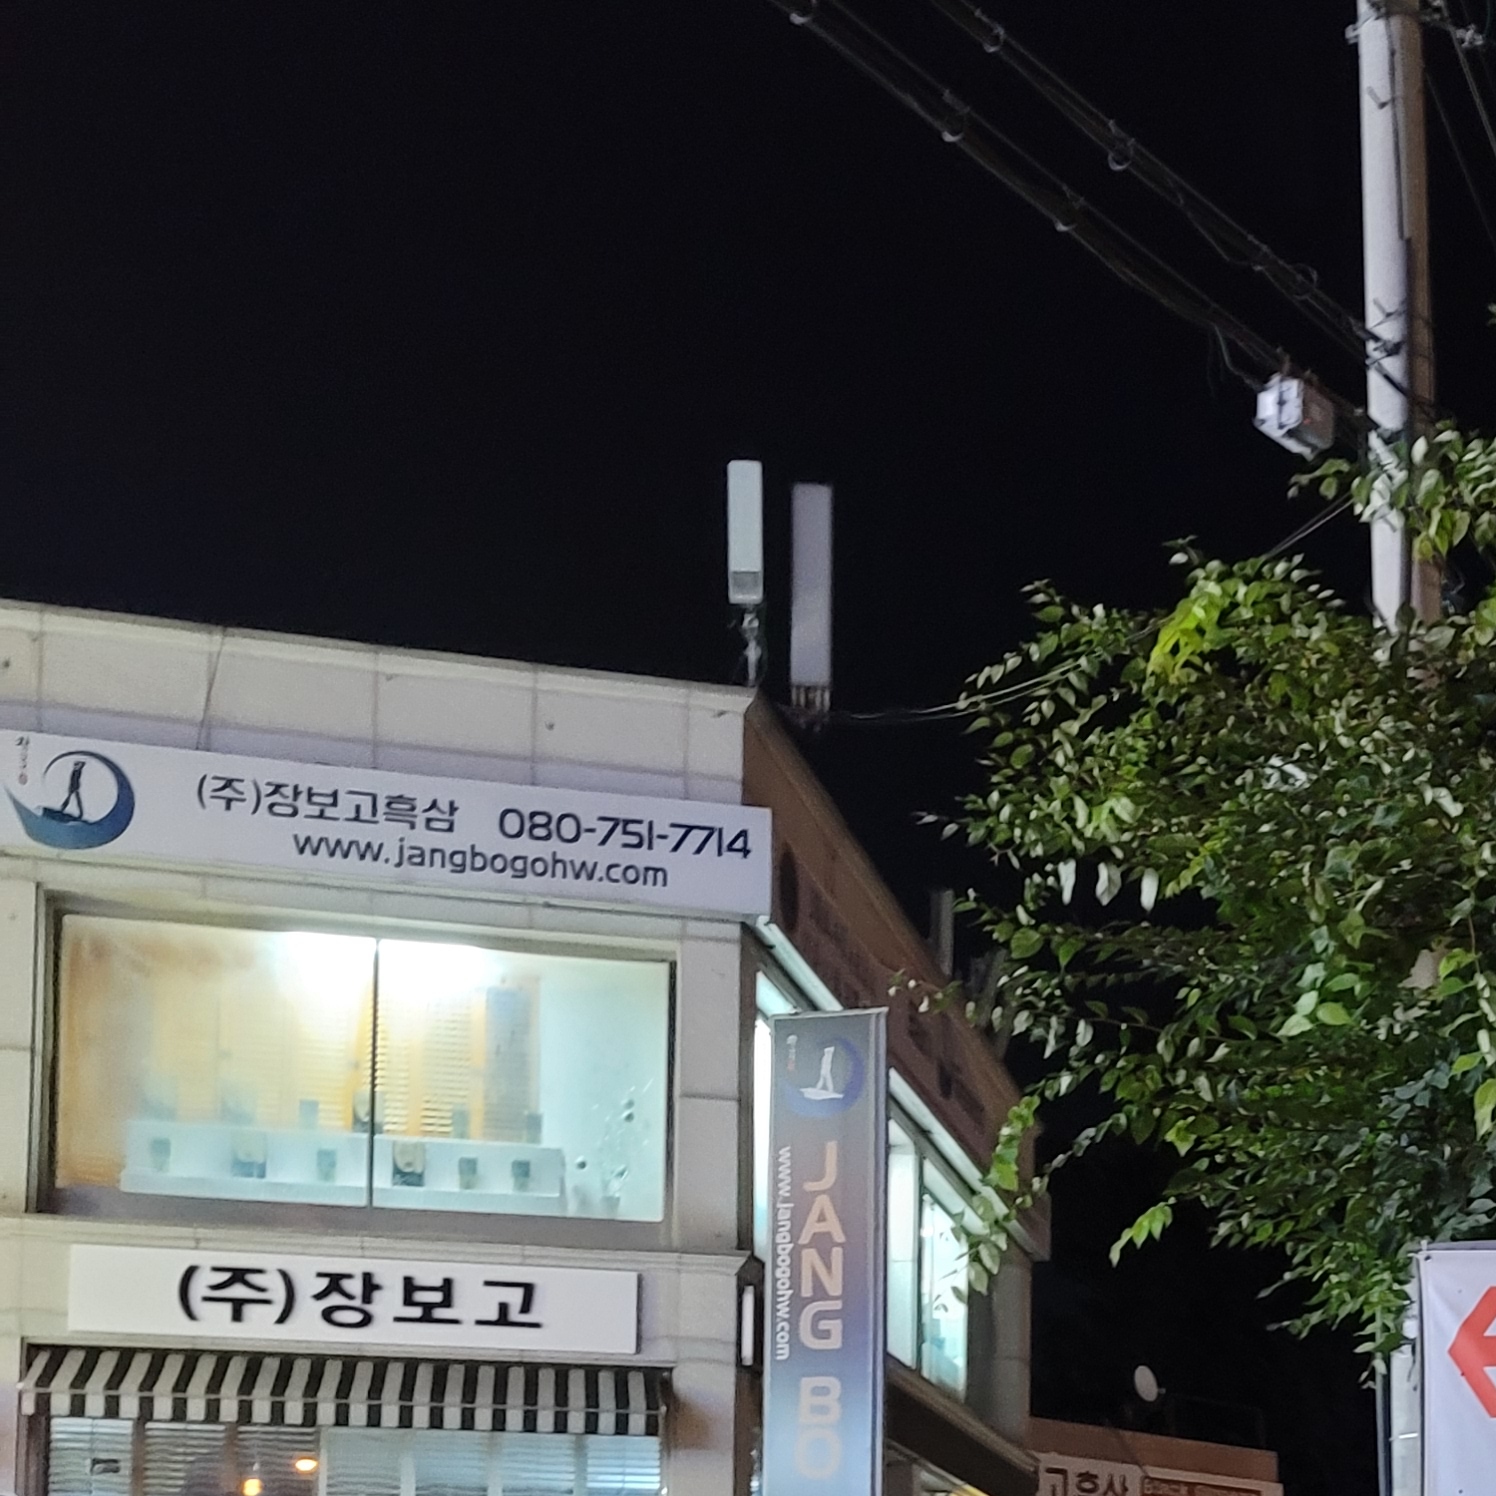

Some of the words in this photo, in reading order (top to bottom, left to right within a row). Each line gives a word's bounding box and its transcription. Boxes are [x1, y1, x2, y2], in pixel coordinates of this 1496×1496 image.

[197, 773, 458, 833] (주)장보고흑삼
[499, 807, 752, 860] 080-751-7714
[293, 832, 669, 887] www.jangbogohw.com
[798, 1140, 846, 1350] JANG
[178, 1264, 542, 1328] (주)장보고
